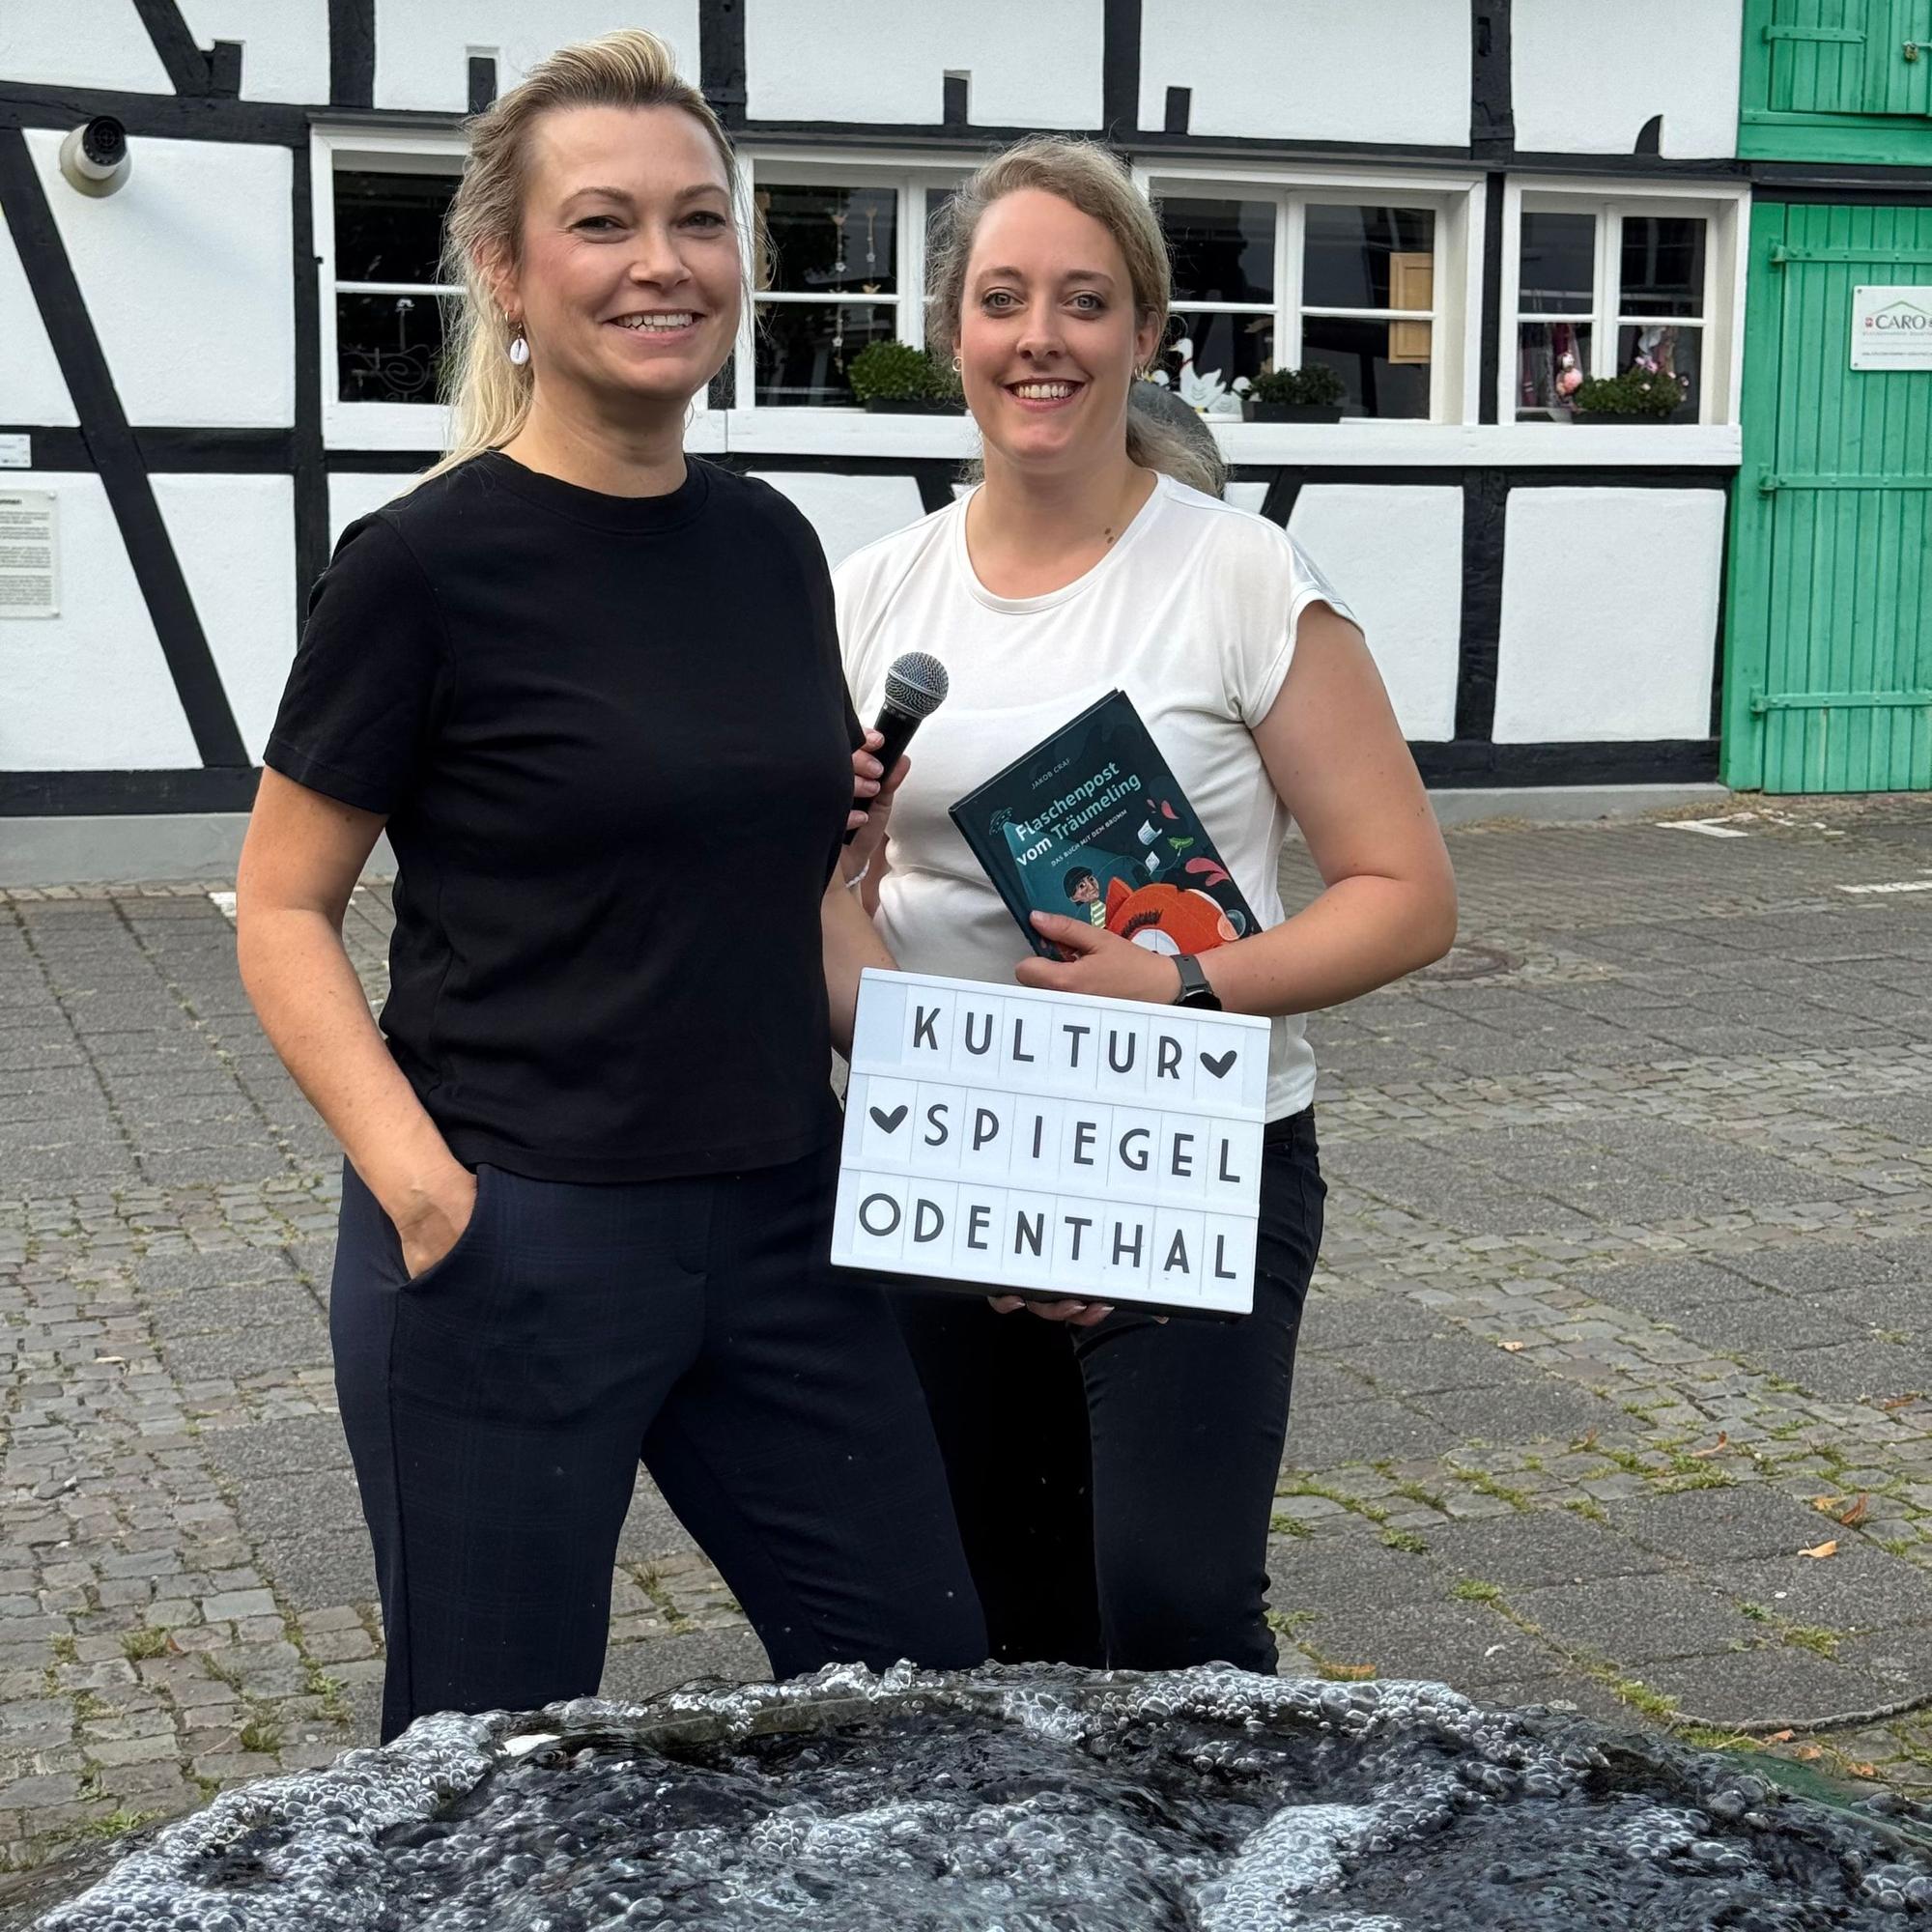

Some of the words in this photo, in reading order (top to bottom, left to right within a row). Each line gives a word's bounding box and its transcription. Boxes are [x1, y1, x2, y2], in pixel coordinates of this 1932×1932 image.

[1875, 314, 1926, 329] CARO
[1015, 762, 1120, 841] Flaschenpost
[1031, 771, 1053, 790] JAKOB
[1016, 838, 1052, 866] vom
[1050, 774, 1141, 839] Träumeling
[1051, 855, 1064, 867] DAS
[1064, 843, 1080, 858] BUCH
[1080, 835, 1091, 845] MIT
[1092, 825, 1105, 838] DEM
[913, 1006, 1182, 1080] KULTUR
[924, 1104, 1240, 1183] SPIEGEL
[859, 1193, 1236, 1280] ODENTHAL
